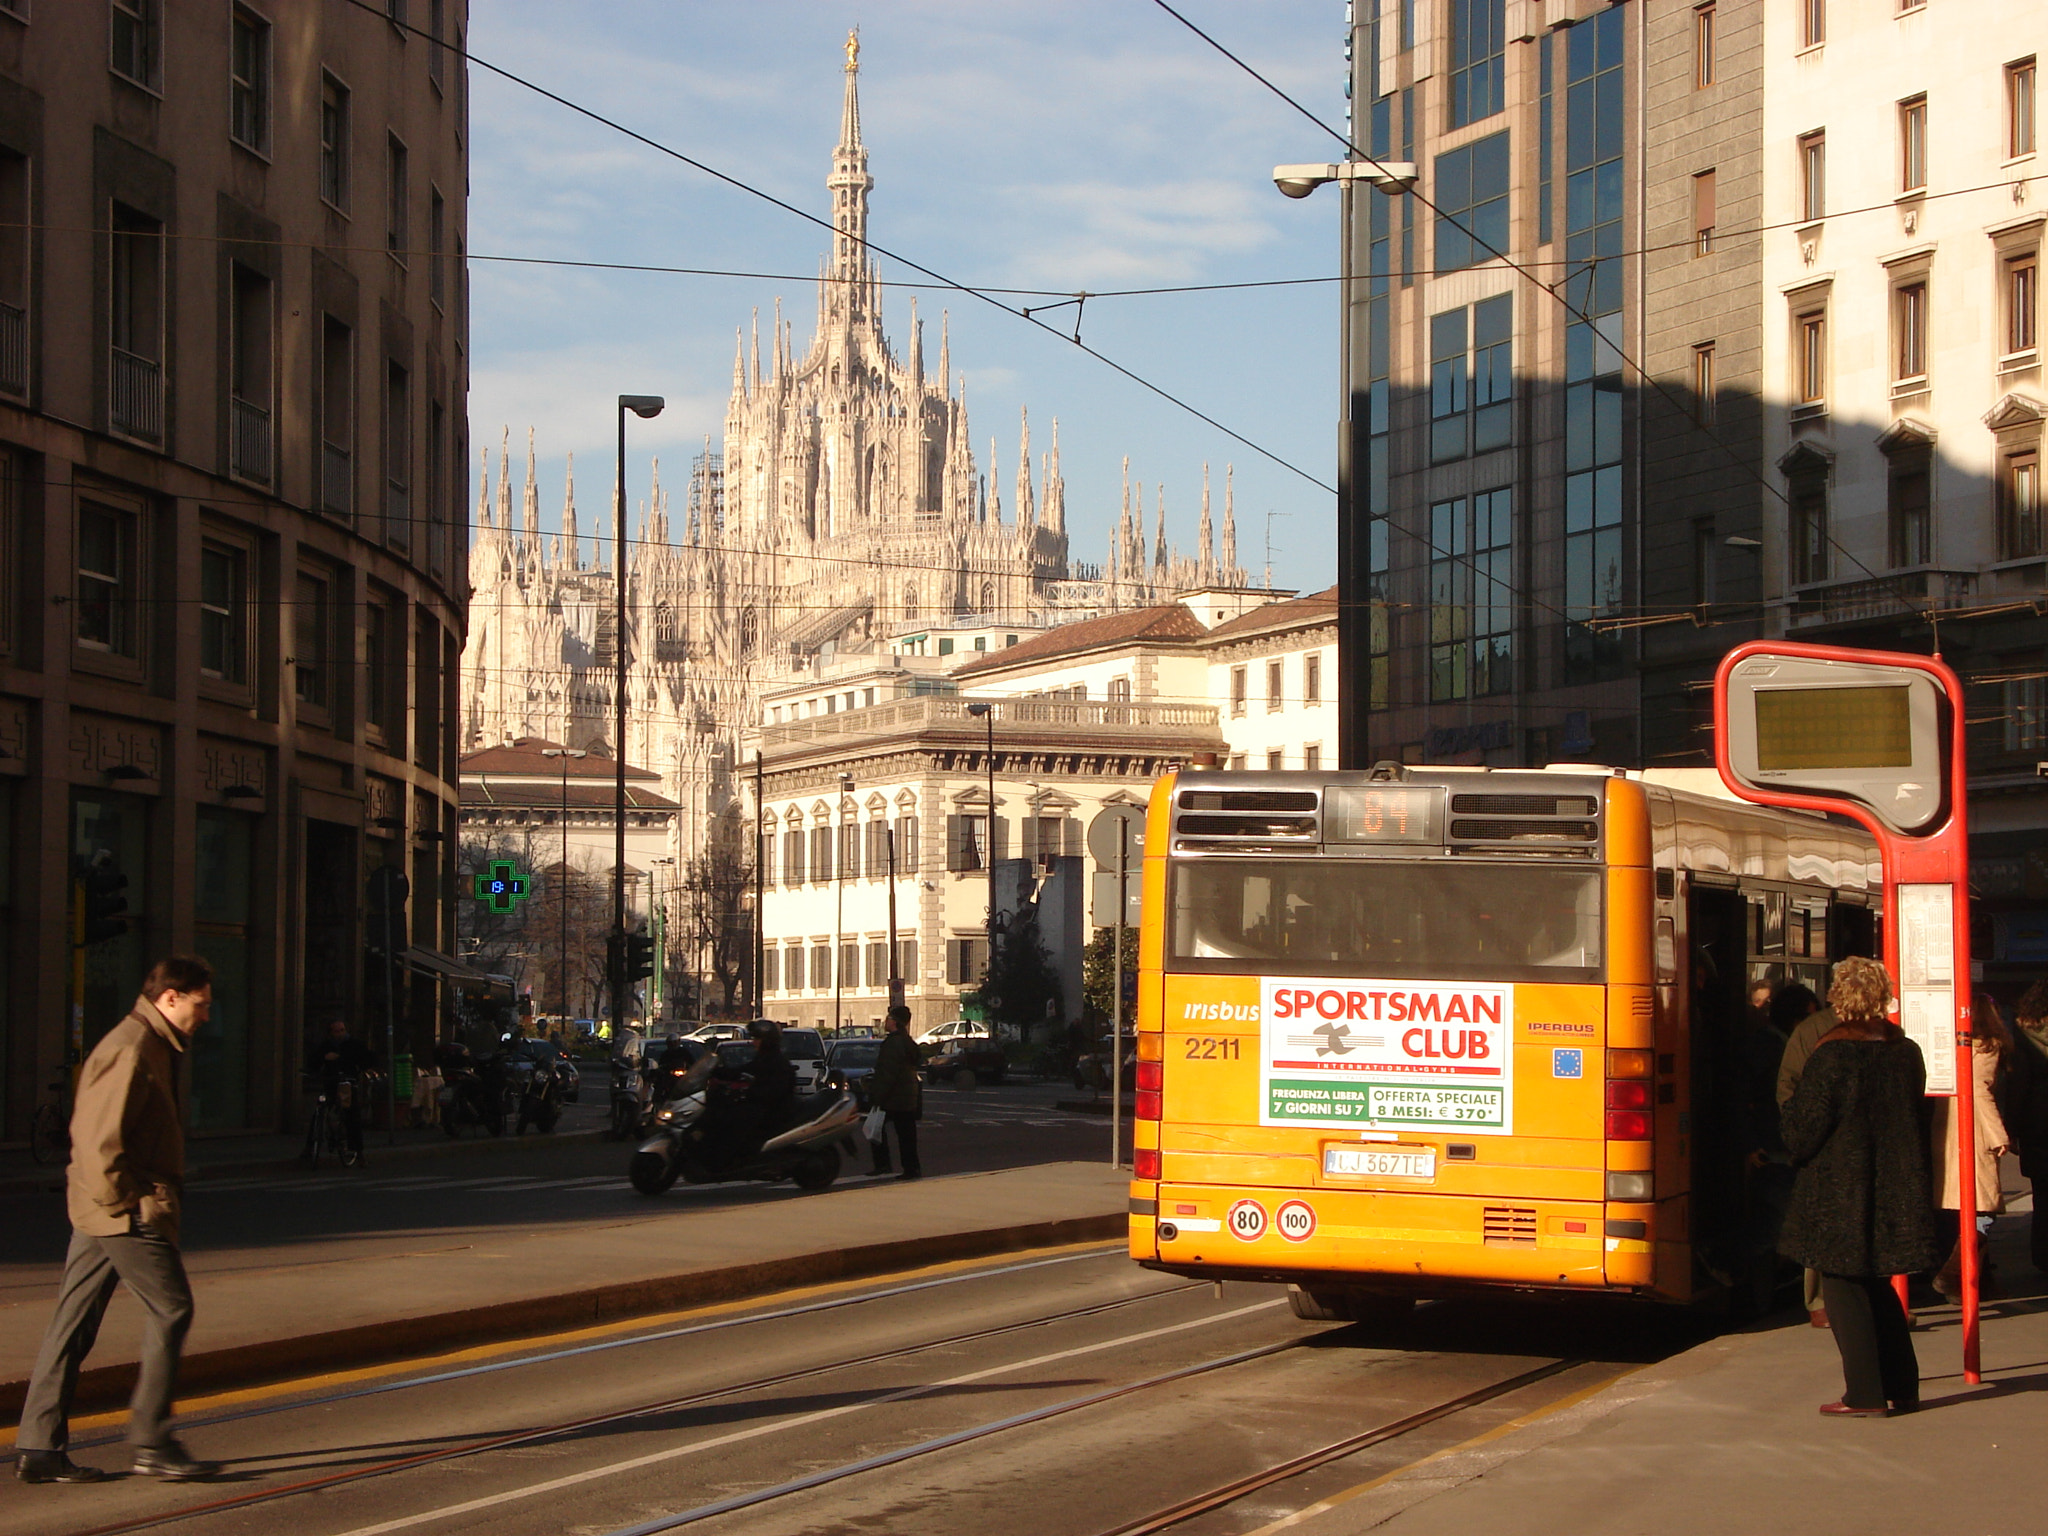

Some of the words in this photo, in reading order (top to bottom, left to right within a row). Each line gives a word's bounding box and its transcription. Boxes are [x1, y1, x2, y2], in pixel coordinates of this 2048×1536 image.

[1364, 791, 1409, 834] 84
[1123, 973, 1134, 988] P
[1184, 1001, 1260, 1021] irisbus
[1274, 988, 1501, 1024] SPORTSMAN
[1528, 1022, 1595, 1032] IPERBUS
[1185, 1037, 1240, 1060] 2211
[1401, 1028, 1491, 1059] CLUB
[1272, 1089, 1330, 1101] FREQUENZA
[1332, 1090, 1366, 1101] LIBERA
[1373, 1090, 1431, 1103] OFFERTA
[1436, 1092, 1497, 1105] SPECIALE
[1273, 1102, 1282, 1113] 7
[1285, 1102, 1332, 1115] GIORNI
[1335, 1103, 1352, 1115] SU
[1354, 1104, 1364, 1116] 7
[1377, 1105, 1386, 1116] 8
[1392, 1106, 1433, 1118] MESI:
[1438, 1106, 1449, 1118] €
[1367, 1154, 1424, 1175] 367TE
[1237, 1210, 1260, 1230] 80
[1285, 1213, 1308, 1229] 100
